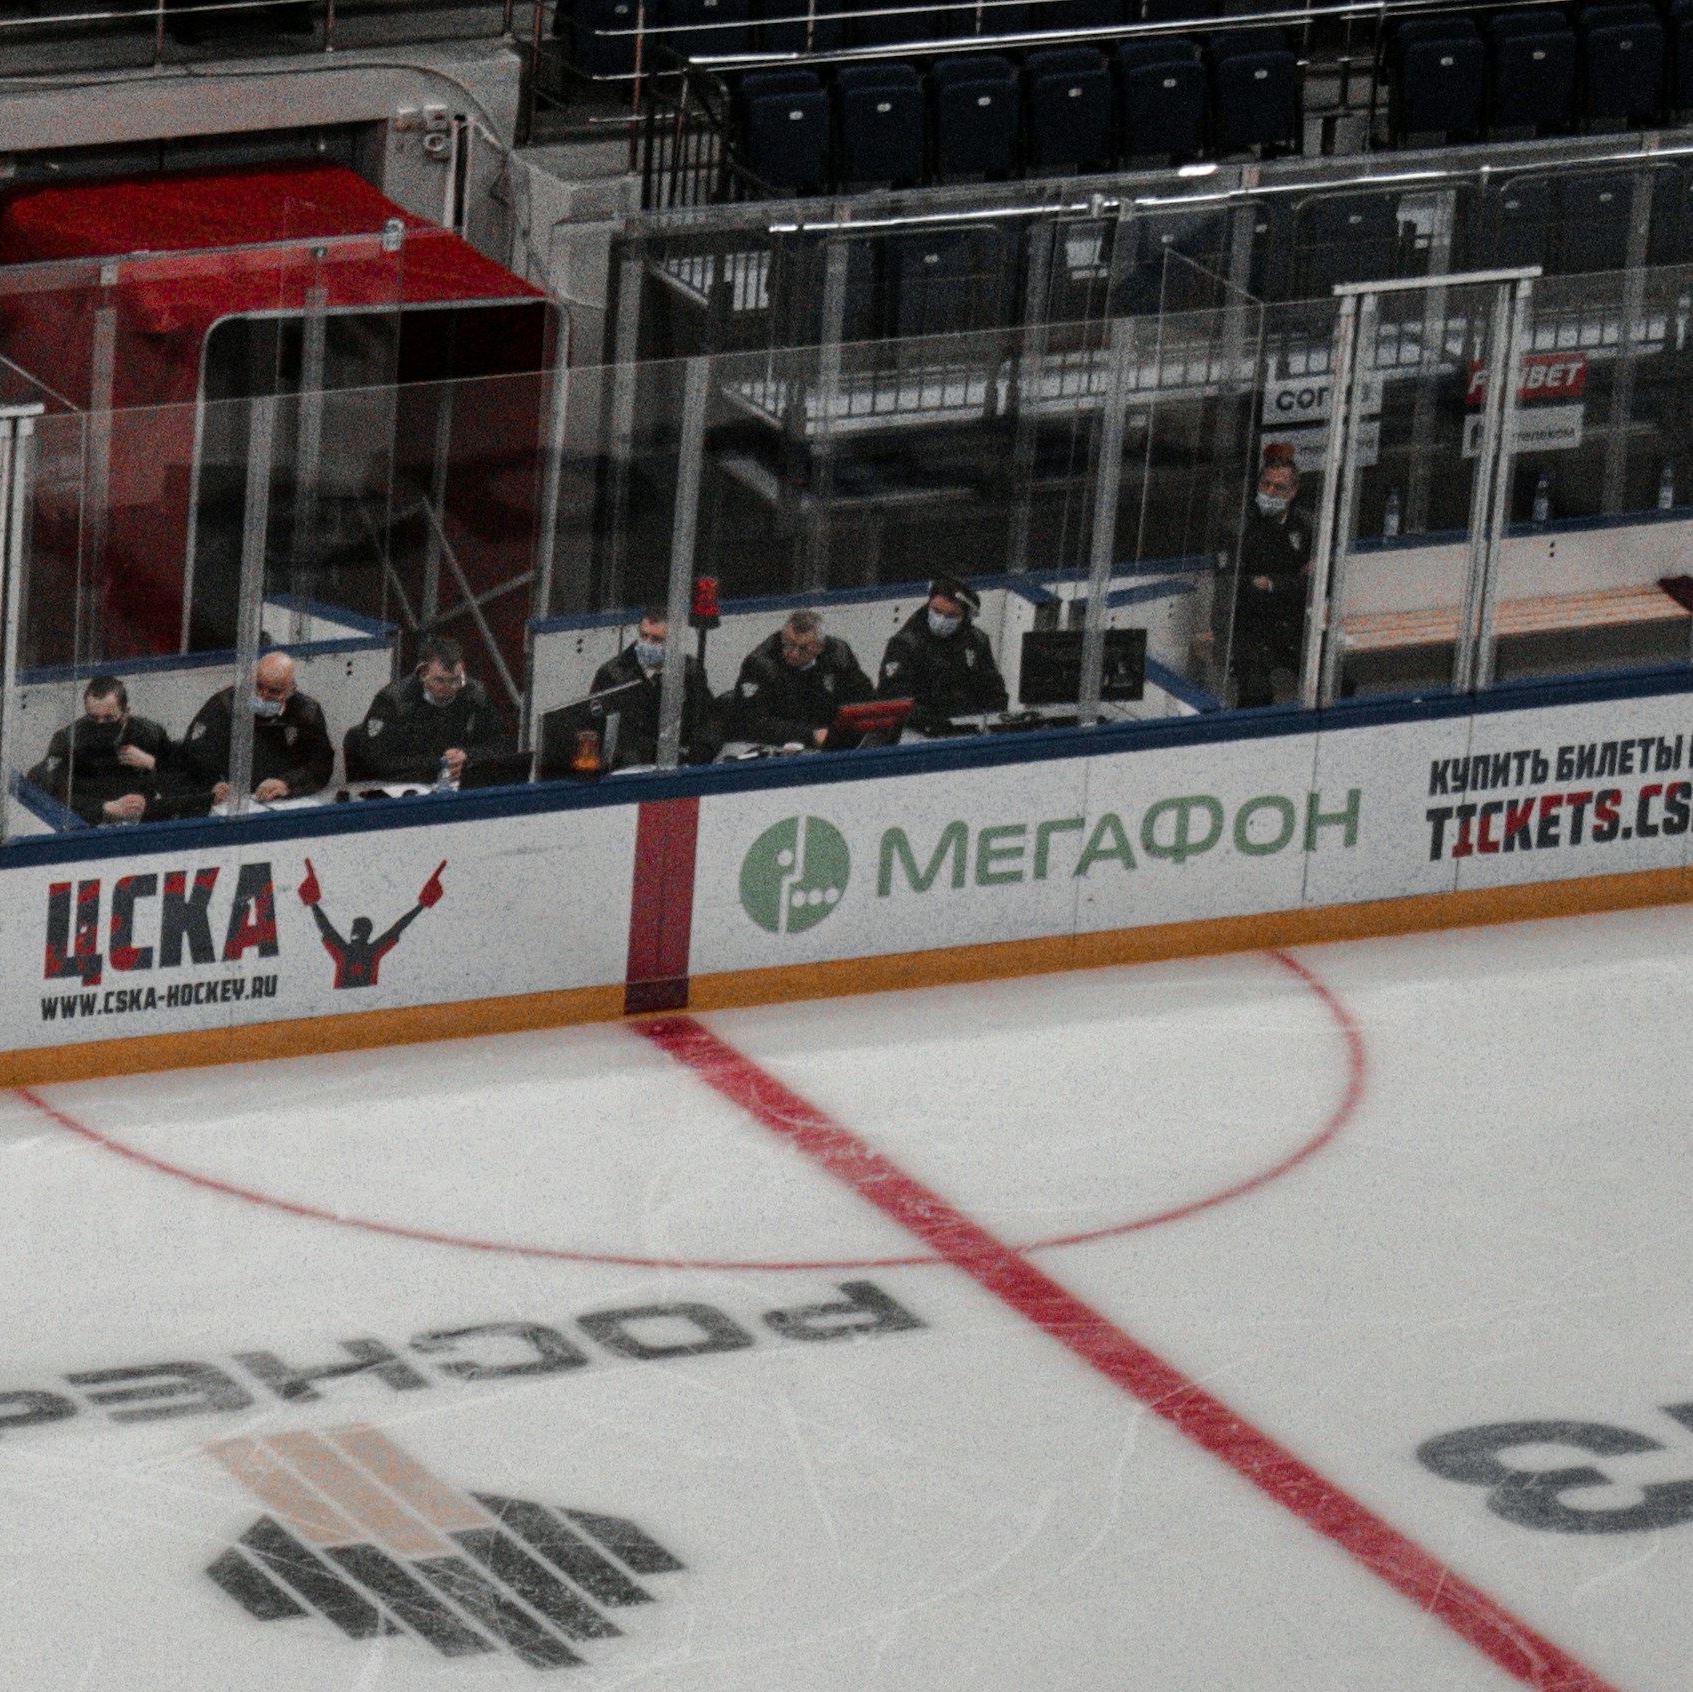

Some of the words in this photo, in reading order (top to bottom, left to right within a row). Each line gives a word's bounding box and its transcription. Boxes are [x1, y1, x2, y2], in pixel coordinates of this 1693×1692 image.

[1428, 749, 1549, 796] КУПИТЬ
[1555, 734, 1684, 782] БИЛЕТЫ
[1426, 781, 1693, 862] TICKETS.CS
[43, 862, 279, 987] ЦСКА
[41, 974, 278, 1021] WWW.CSKA-HOCKEY.RU
